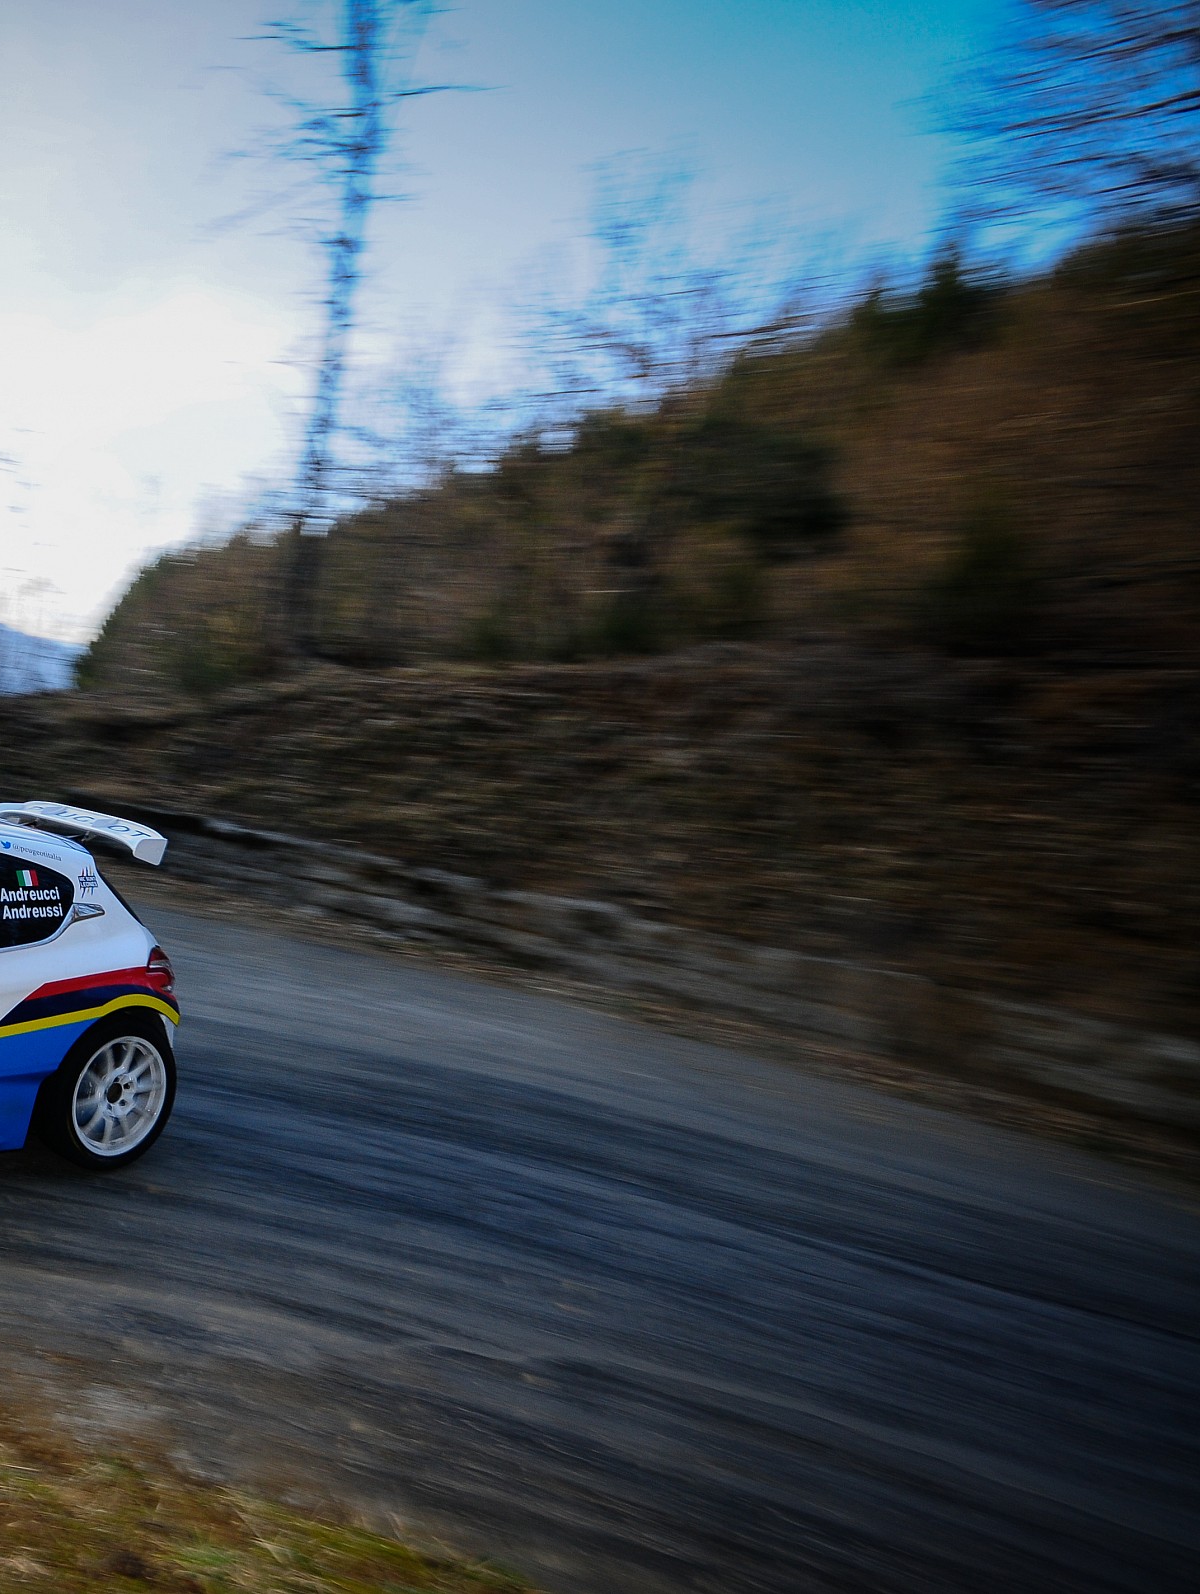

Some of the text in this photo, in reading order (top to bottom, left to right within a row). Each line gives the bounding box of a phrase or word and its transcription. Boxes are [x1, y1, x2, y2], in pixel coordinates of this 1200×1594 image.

[29, 806, 152, 839] PUGOT
[0, 886, 60, 902] Andreucci
[2, 903, 63, 920] Andreussi
